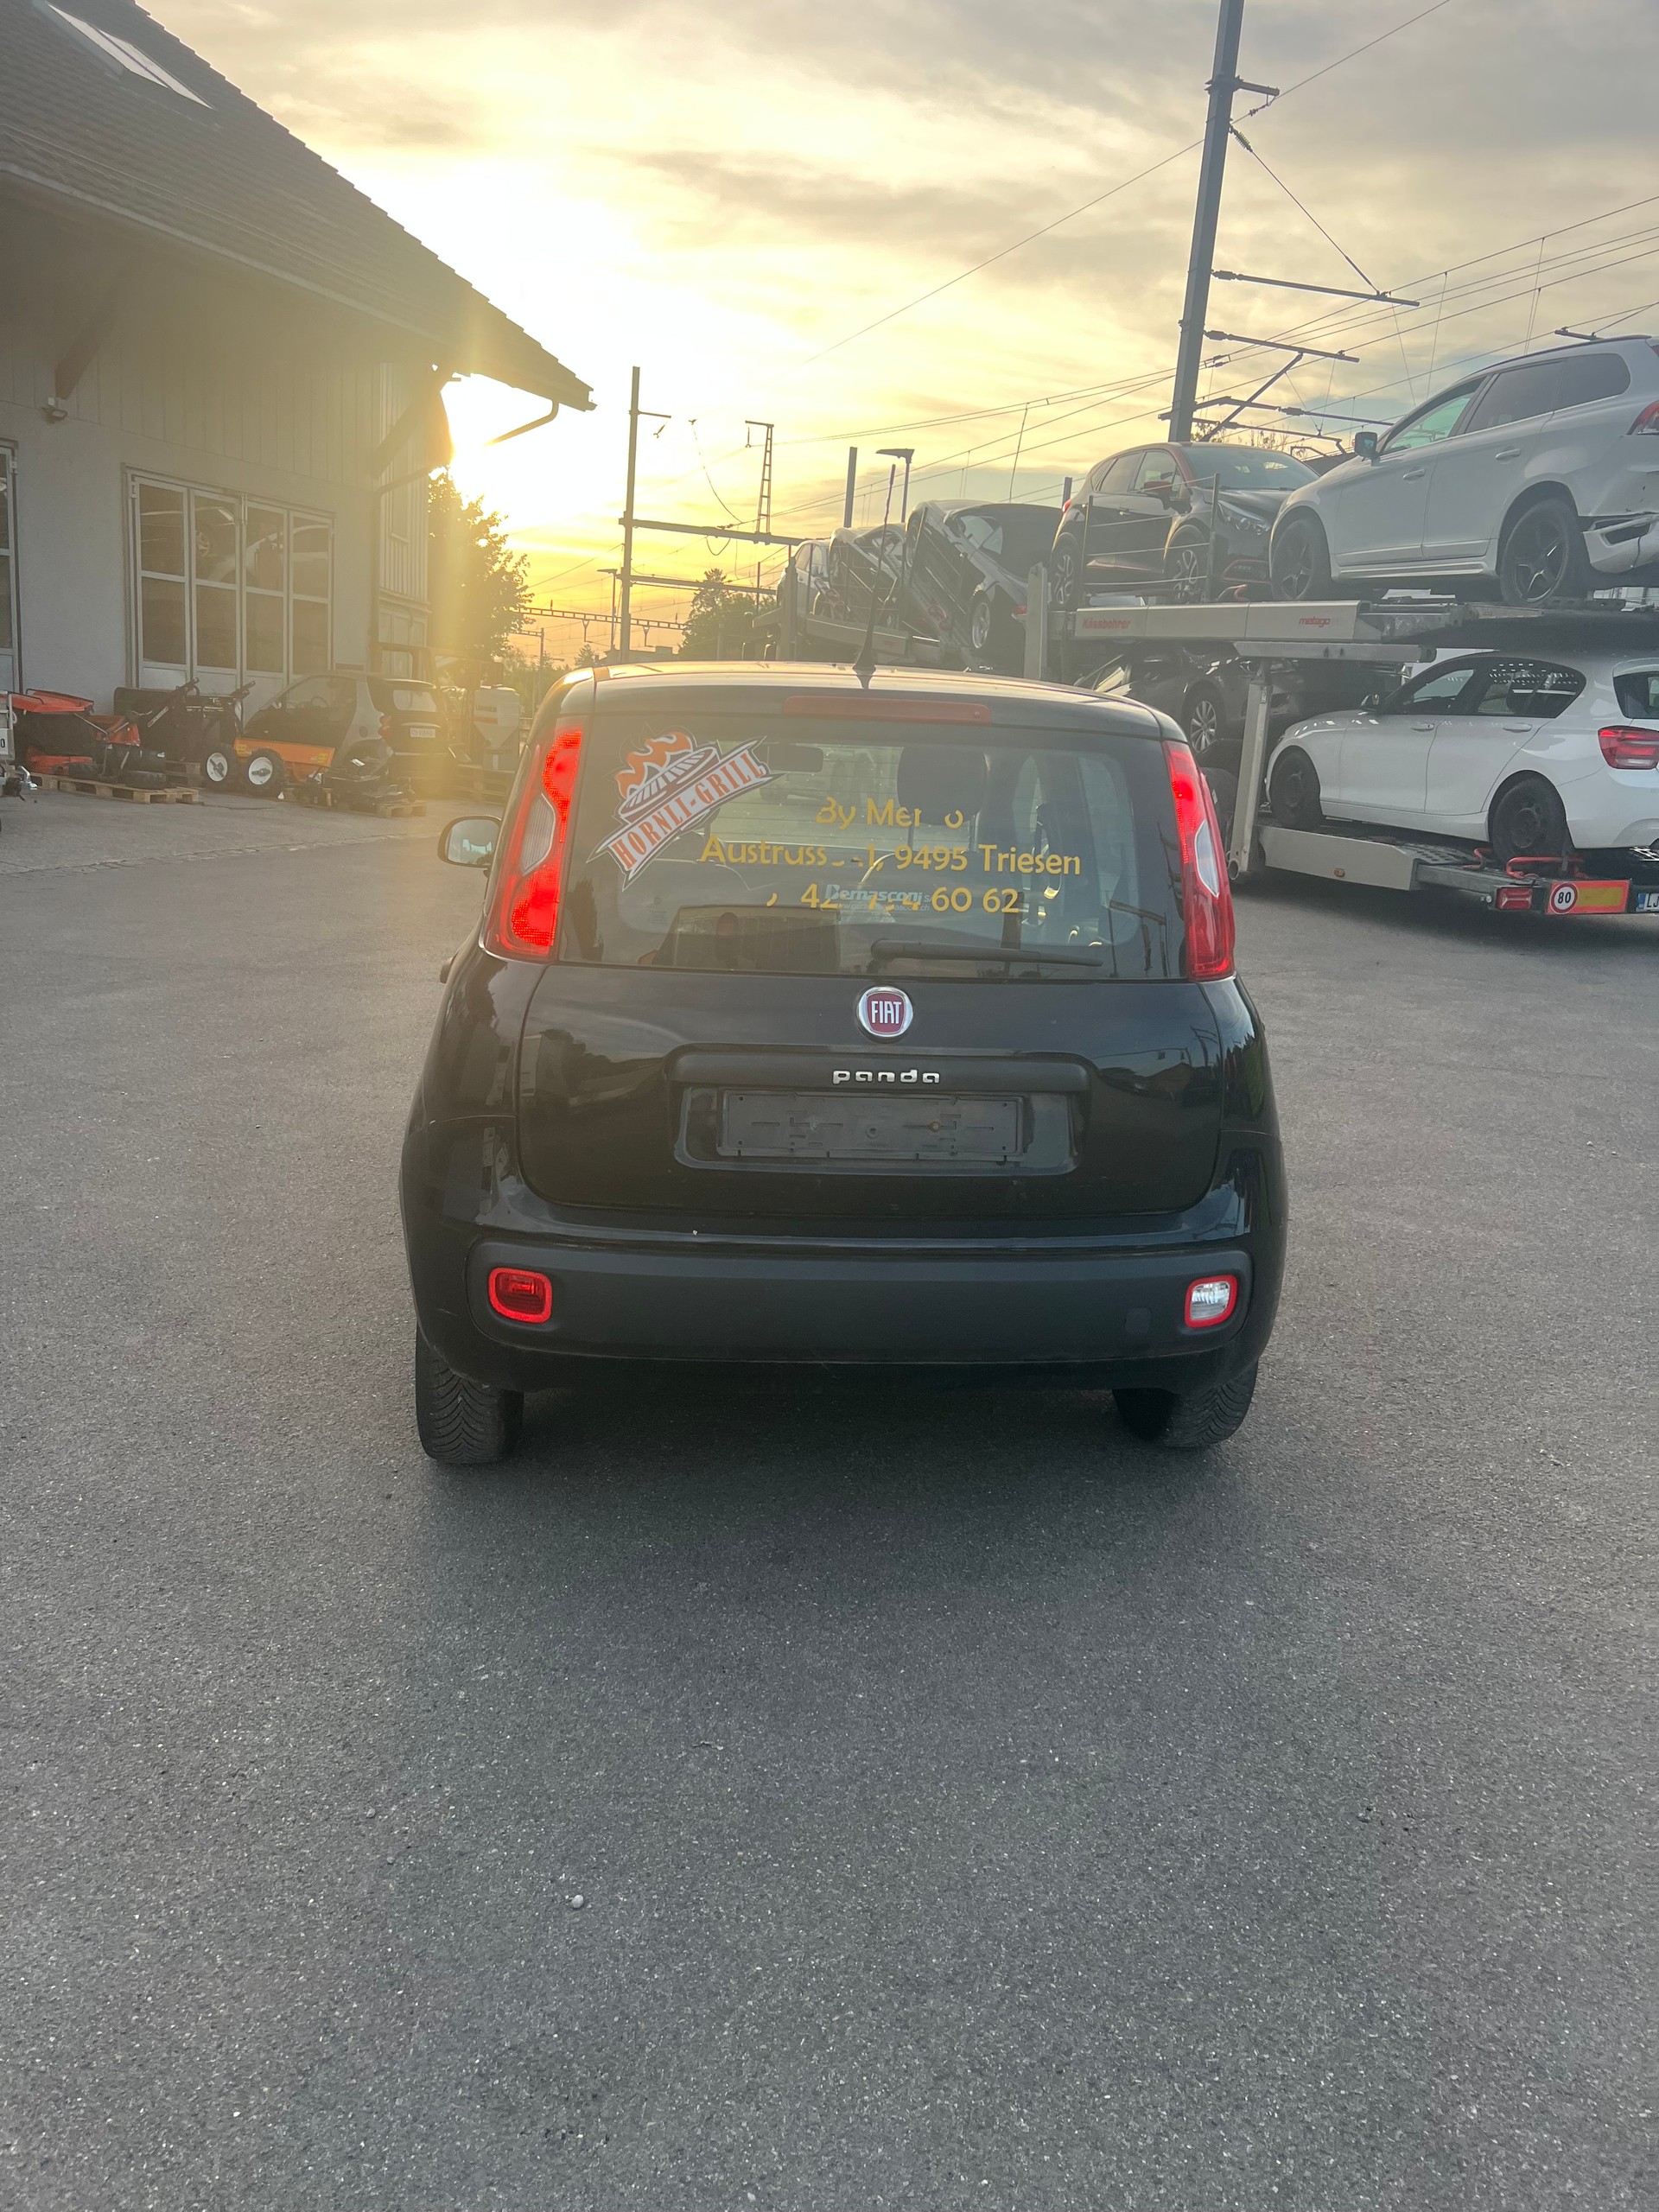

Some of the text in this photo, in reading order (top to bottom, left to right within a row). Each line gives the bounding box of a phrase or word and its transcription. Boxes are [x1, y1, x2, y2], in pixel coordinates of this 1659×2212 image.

[893, 843, 969, 871] 9495
[977, 843, 1082, 875] Triesen
[931, 887, 974, 912] 60
[982, 887, 1020, 913] 62
[1557, 891, 1572, 905] 80
[871, 1001, 902, 1025] FIAT
[832, 1069, 940, 1085] panda
